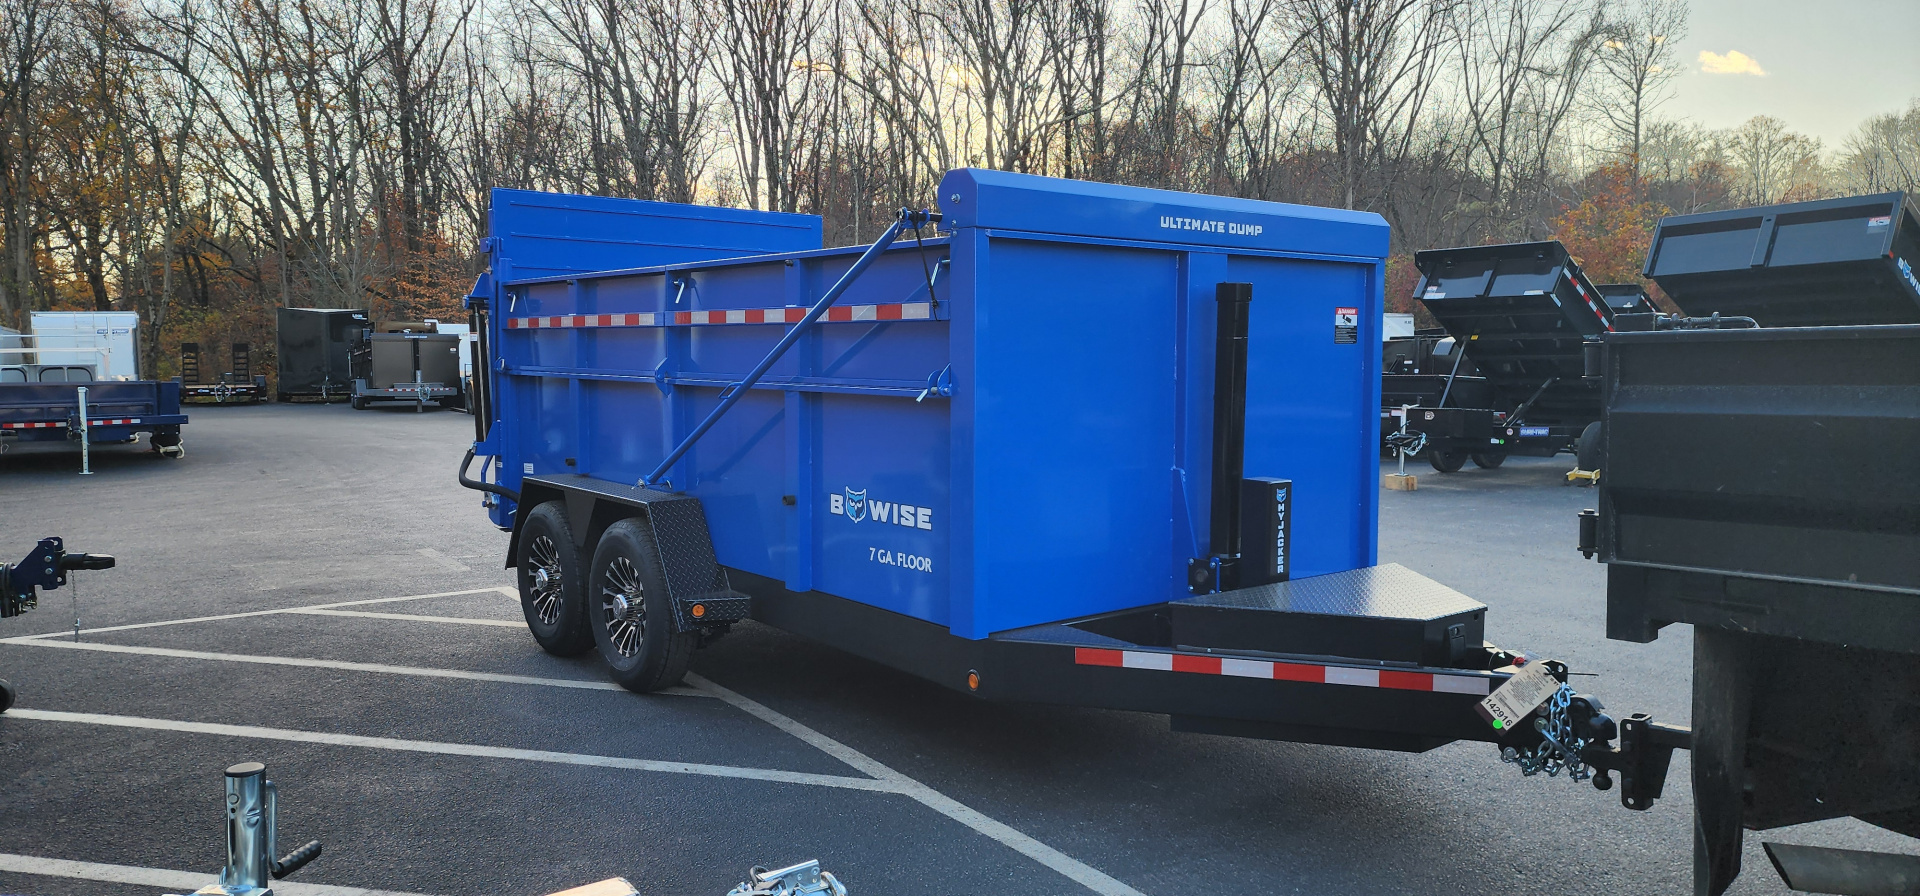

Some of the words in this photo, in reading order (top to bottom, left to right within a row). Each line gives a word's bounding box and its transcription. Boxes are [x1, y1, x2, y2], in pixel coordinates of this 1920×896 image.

[1160, 216, 1225, 233] ULTIMATE
[1228, 222, 1263, 236] DUMP
[1277, 503, 1285, 574] HYJACKER
[869, 547, 876, 561] 7
[877, 549, 896, 566] GA.
[897, 552, 932, 573] FLOOR
[1485, 698, 1514, 727] 142916
